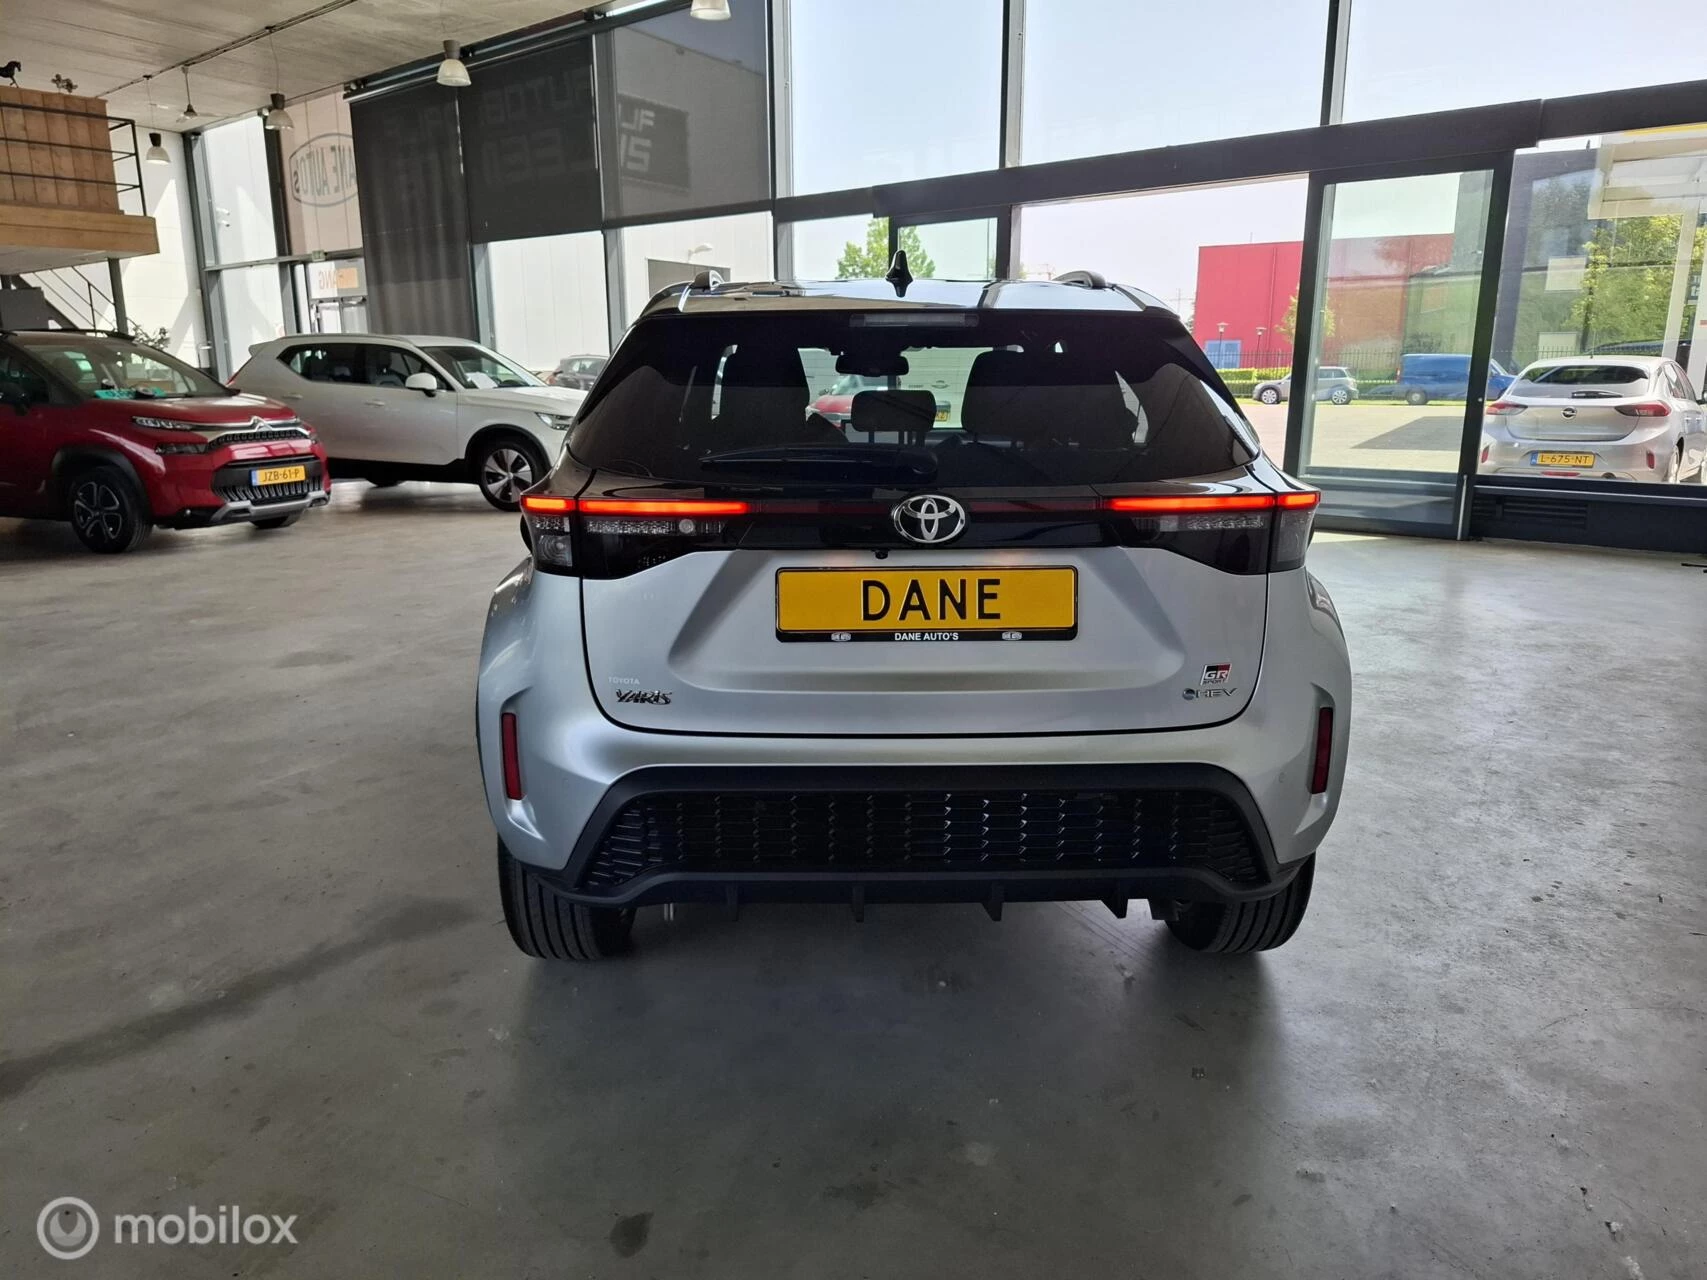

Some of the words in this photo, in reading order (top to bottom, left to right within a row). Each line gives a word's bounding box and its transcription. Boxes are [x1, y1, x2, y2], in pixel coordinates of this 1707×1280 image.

[262, 468, 300, 482] JZB-61-P
[861, 578, 1001, 621] DANE
[894, 632, 921, 641] DANE
[922, 632, 959, 641] AUTO'S
[1204, 670, 1229, 680] GR
[608, 676, 640, 685] TOYOTA
[616, 689, 673, 705] YARIS
[1196, 688, 1238, 698] HEV
